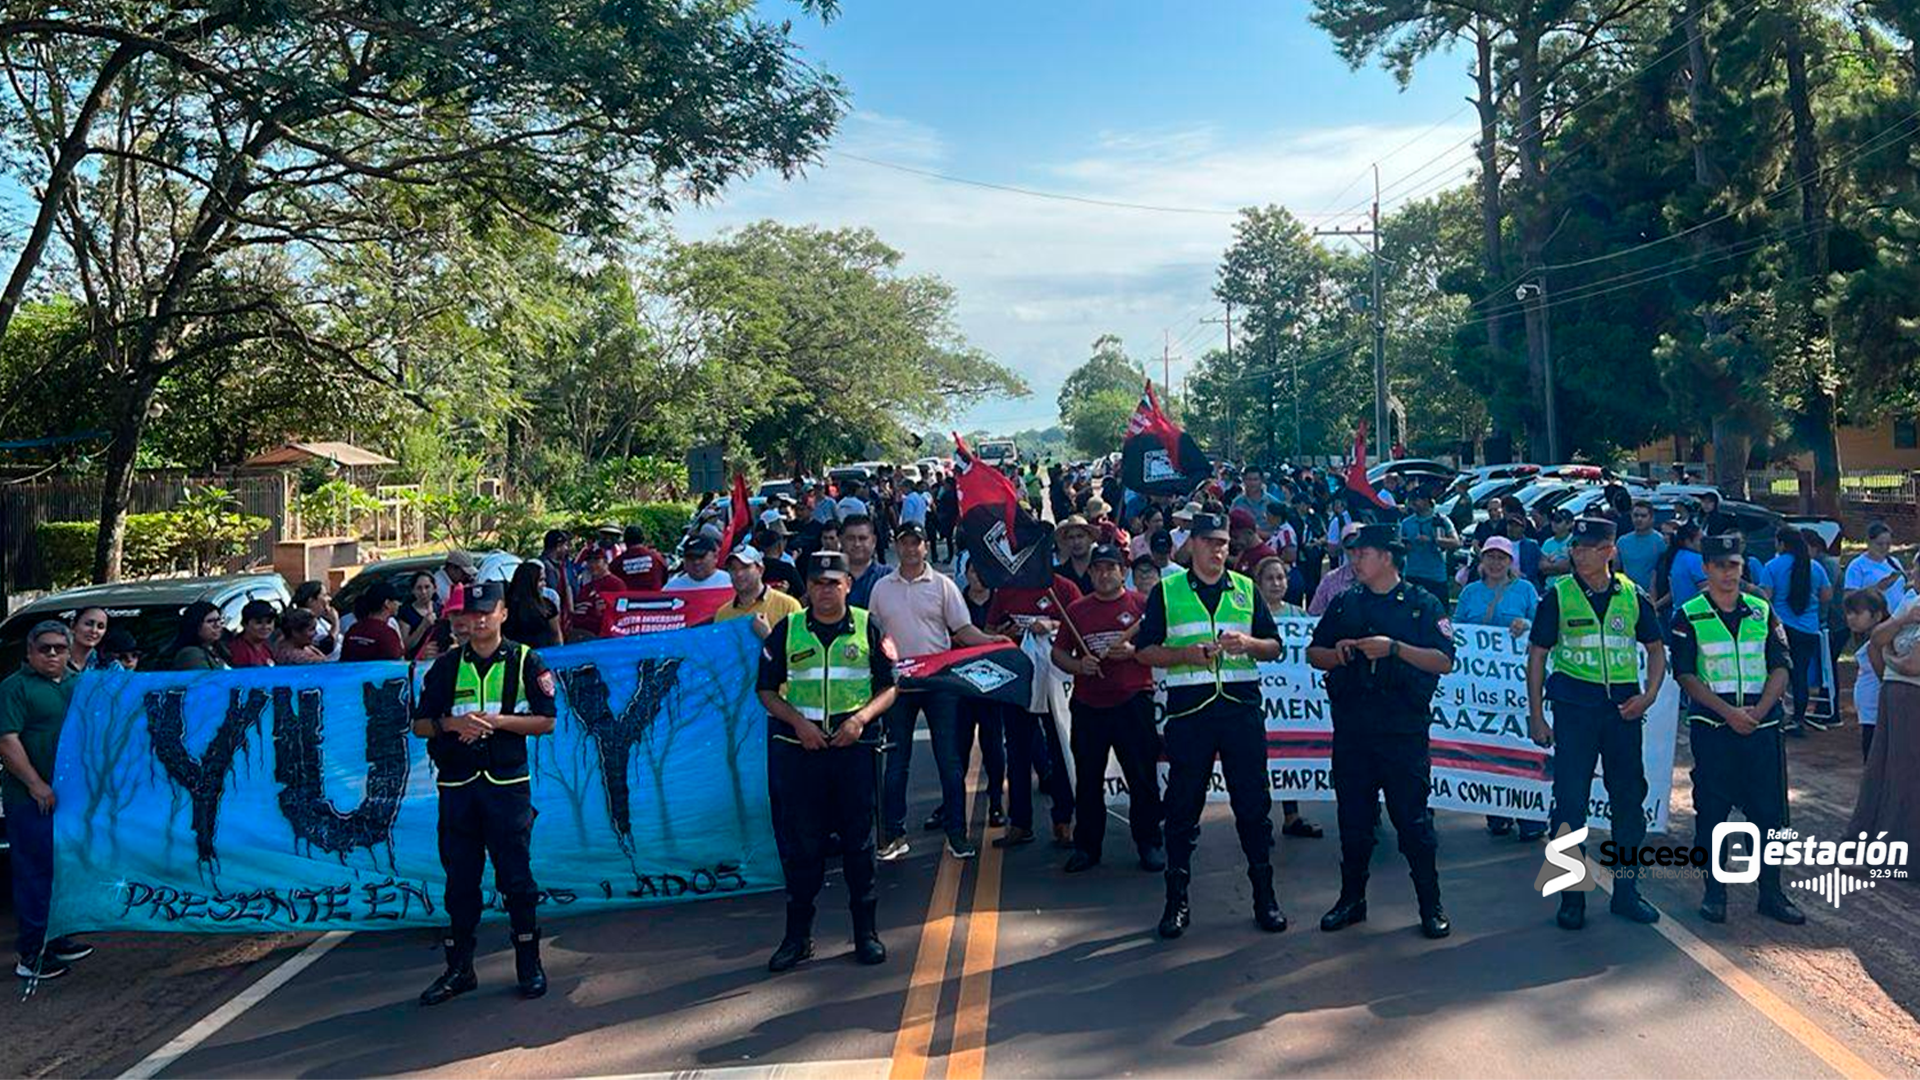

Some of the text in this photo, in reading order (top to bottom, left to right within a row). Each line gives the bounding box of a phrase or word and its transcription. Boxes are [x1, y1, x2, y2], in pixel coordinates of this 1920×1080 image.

[1453, 628, 1468, 648] S
[1475, 629, 1504, 653] DE
[1451, 656, 1527, 683] DICATO
[1434, 684, 1447, 699] s
[1453, 687, 1466, 706] y
[1471, 682, 1499, 706] las
[1504, 688, 1528, 709] Re
[1430, 776, 1451, 799] HA
[1457, 781, 1545, 812] CONTINUA
[120, 882, 351, 922] PRESENTE
